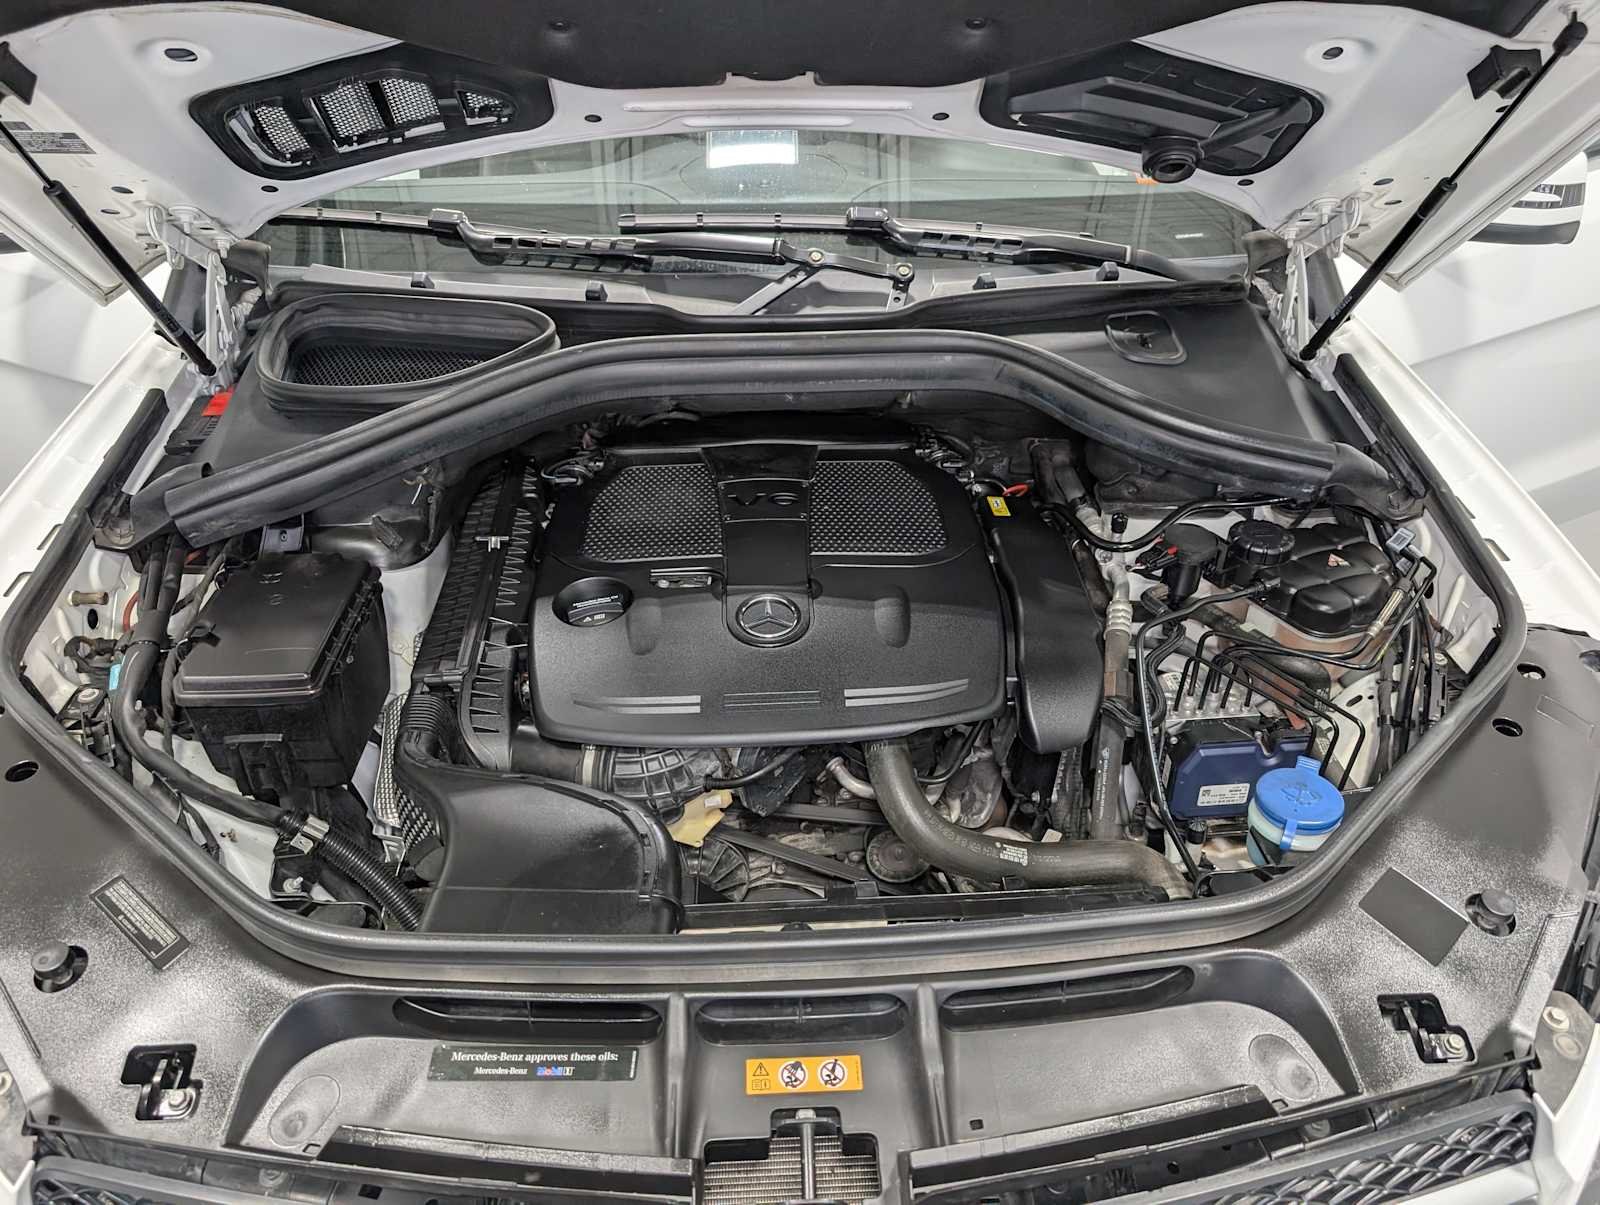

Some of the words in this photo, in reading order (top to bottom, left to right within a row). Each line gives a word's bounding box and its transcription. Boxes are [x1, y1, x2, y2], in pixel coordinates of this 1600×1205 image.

[727, 491, 800, 507] V6
[451, 1051, 524, 1062] Mercedes-Benz
[525, 1053, 568, 1063] approves
[571, 1051, 596, 1062] these
[598, 1051, 619, 1062] oils:
[473, 1066, 528, 1076] Mercedes-Benz
